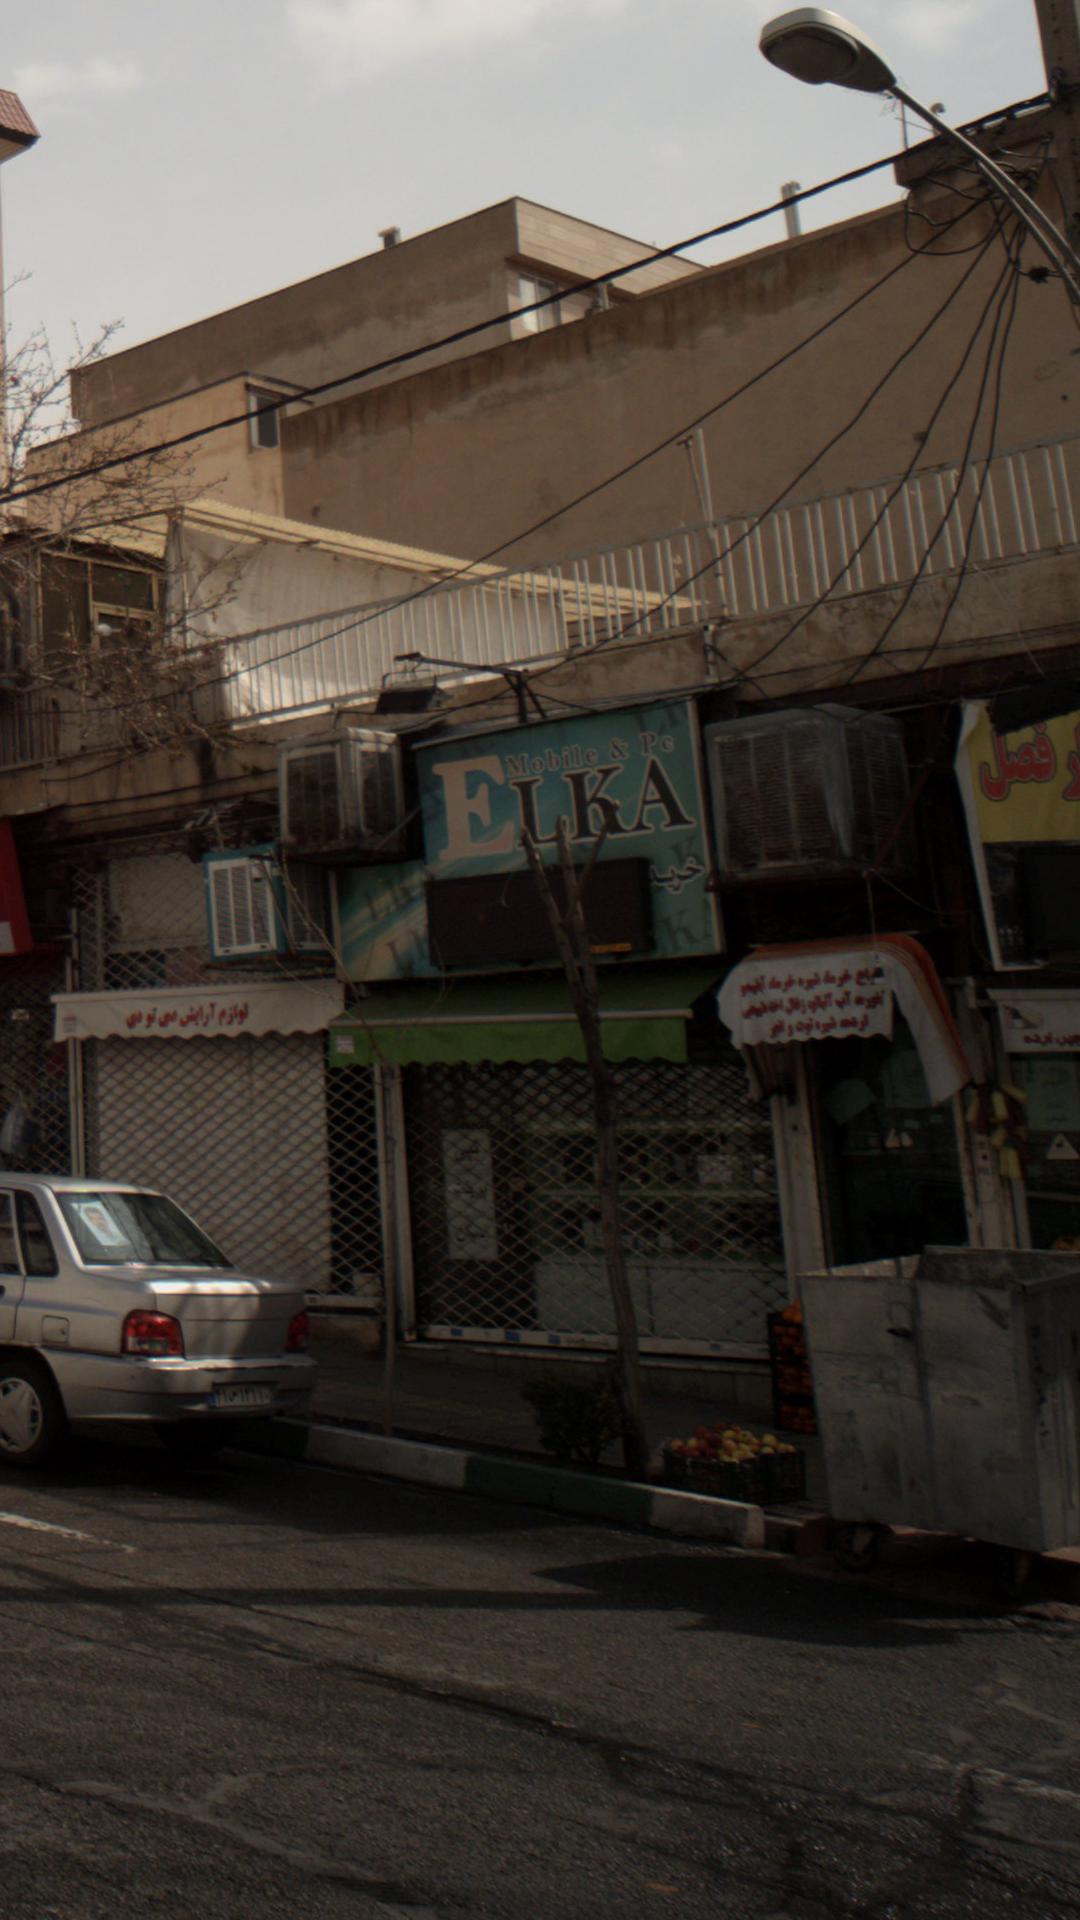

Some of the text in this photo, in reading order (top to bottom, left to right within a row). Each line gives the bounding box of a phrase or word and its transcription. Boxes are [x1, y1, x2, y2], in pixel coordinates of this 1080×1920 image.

[506, 731, 676, 778] Mobile & Pc
[979, 721, 1057, 801] فصل
[432, 754, 697, 862] ELKA
[179, 1001, 217, 1027] آرایش
[219, 1001, 249, 1026] لوازم
